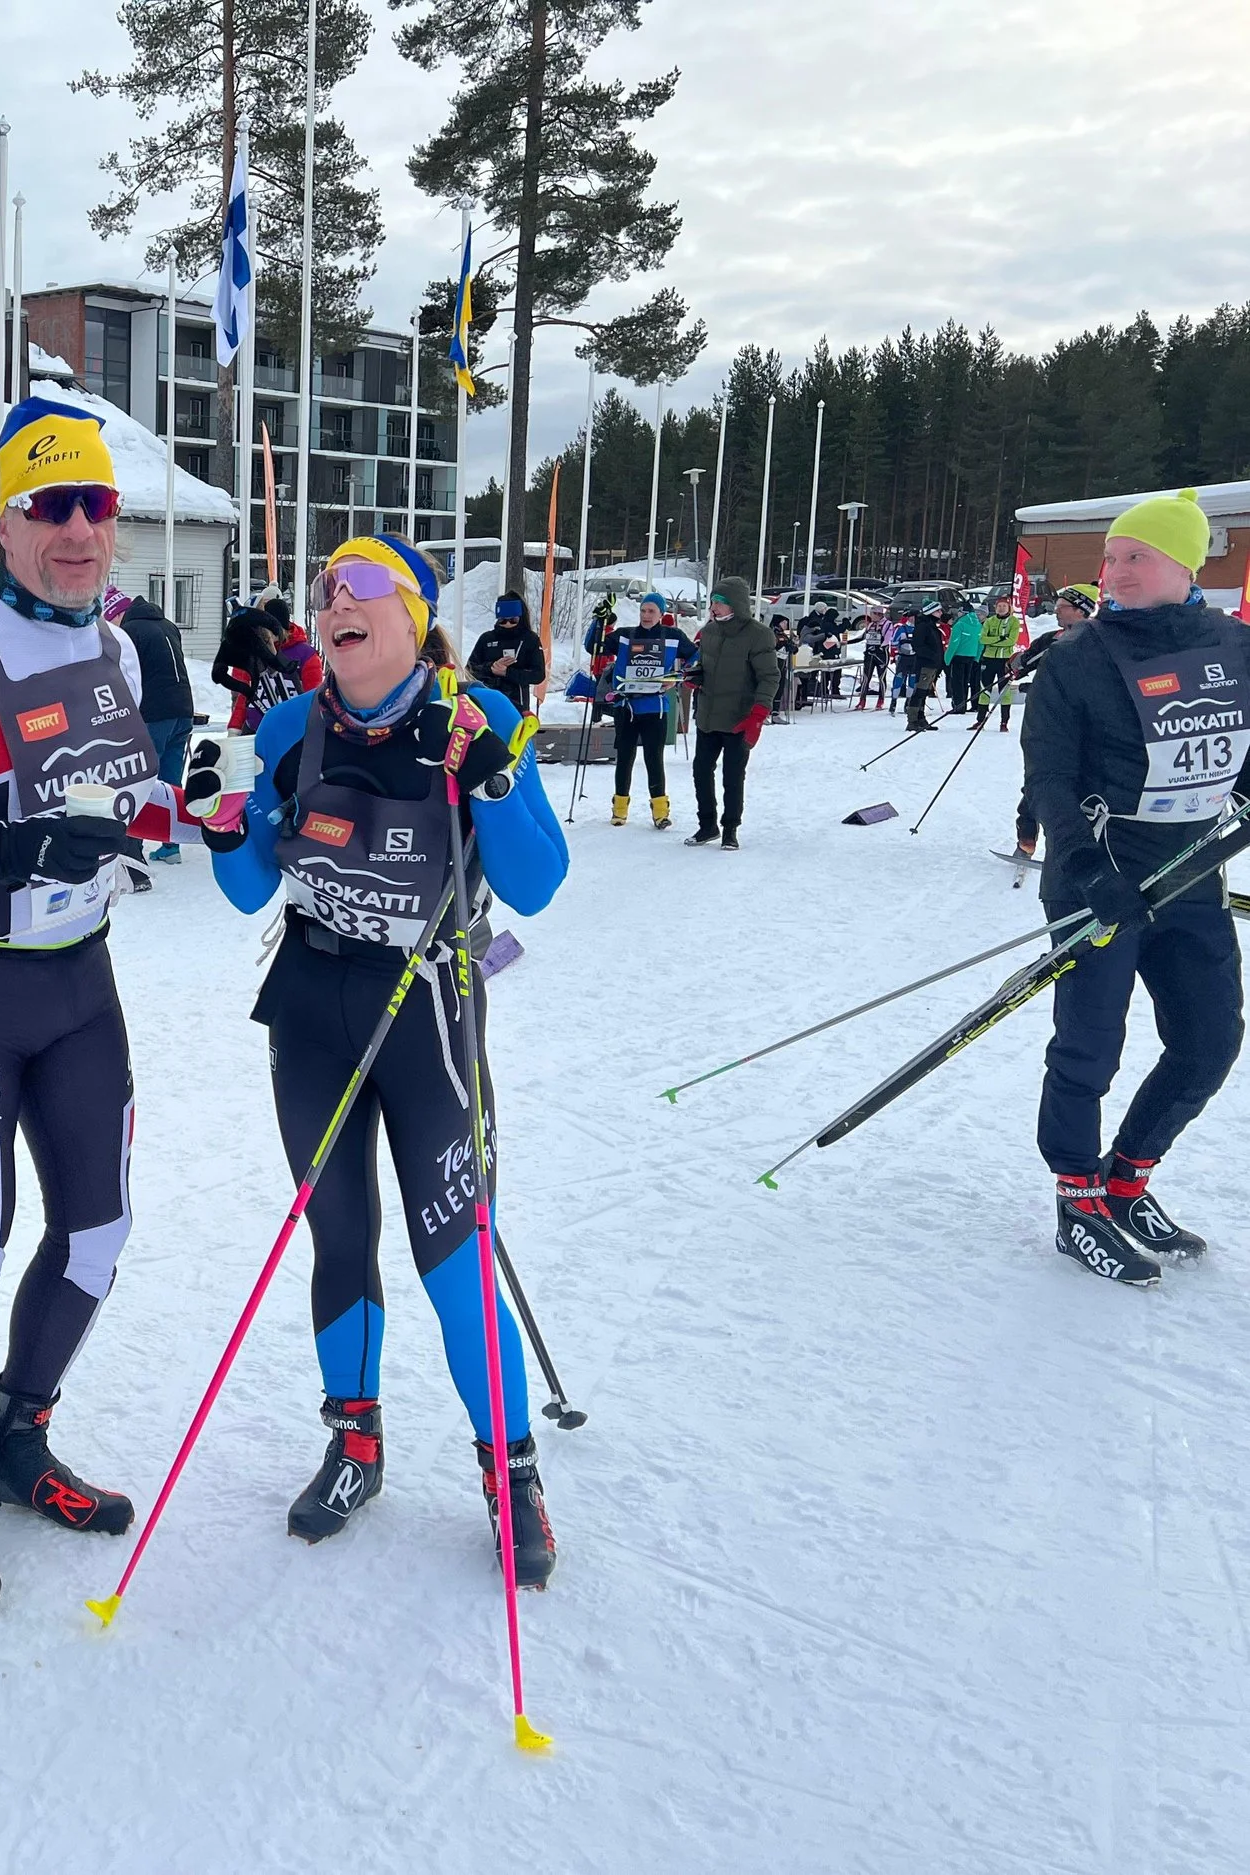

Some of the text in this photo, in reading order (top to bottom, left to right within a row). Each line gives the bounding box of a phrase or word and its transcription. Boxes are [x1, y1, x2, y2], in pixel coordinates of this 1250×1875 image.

[636, 667, 657, 677] 607
[25, 711, 60, 733] START
[1152, 710, 1243, 736] VUOKATTI
[448, 729, 467, 773] LEKI
[1173, 736, 1232, 773] 413
[34, 751, 147, 803] VUOKATTI
[1168, 773, 1207, 784] VUOKATTI
[308, 820, 346, 838] START
[288, 865, 420, 913] VUOKATTI
[455, 929, 470, 997] LEKI
[387, 952, 423, 1017] LEKI
[1071, 1223, 1125, 1278] ROSSI
